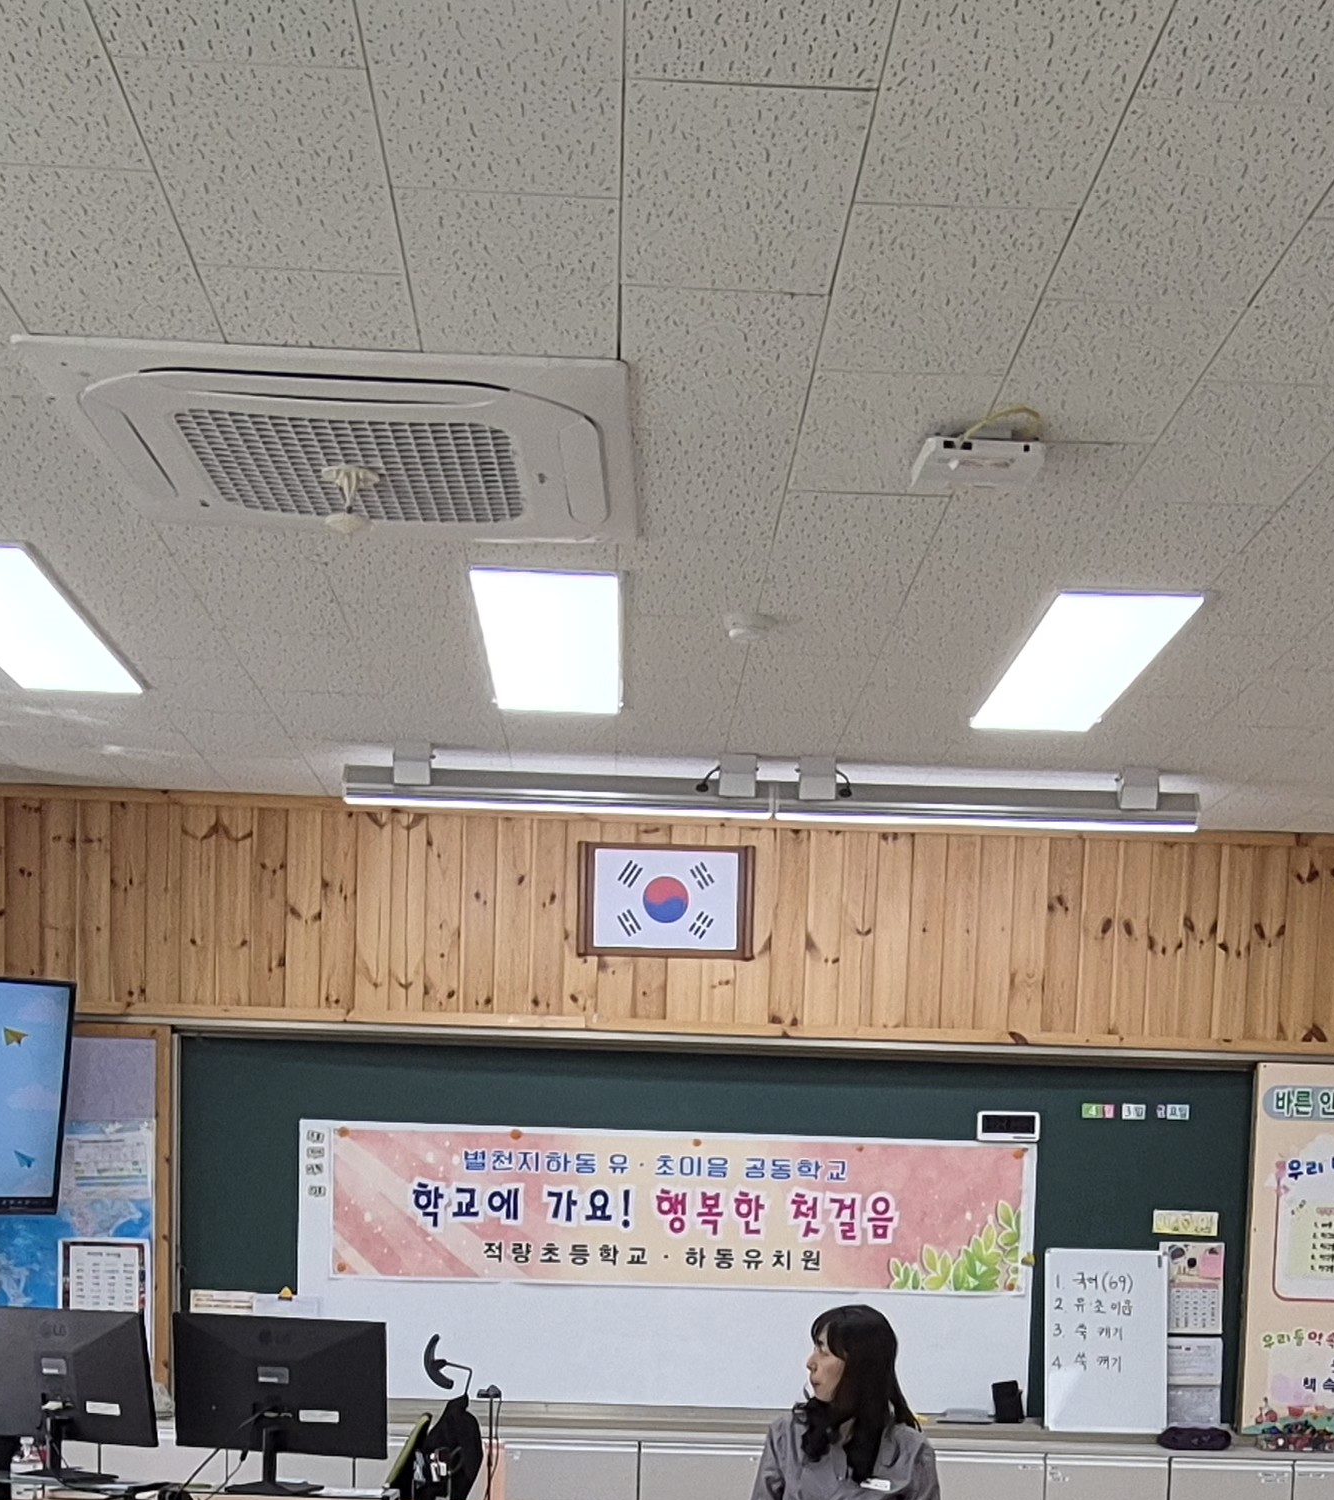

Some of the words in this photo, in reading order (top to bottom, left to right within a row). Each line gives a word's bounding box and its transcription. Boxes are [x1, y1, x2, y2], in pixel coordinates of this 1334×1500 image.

[1275, 1088, 1312, 1115] 바른
[464, 1150, 596, 1175] 별천지하동
[609, 1154, 628, 1174] 유
[745, 1157, 847, 1181] 공동학교
[1288, 1159, 1323, 1180] 우리
[412, 1182, 520, 1228] 학교에
[547, 1188, 631, 1229] 가요!
[655, 1188, 765, 1235] 행복한
[790, 1192, 894, 1240] 첫걸음
[483, 1241, 648, 1266] 적량초등학교
[685, 1247, 821, 1271] 하동유치원
